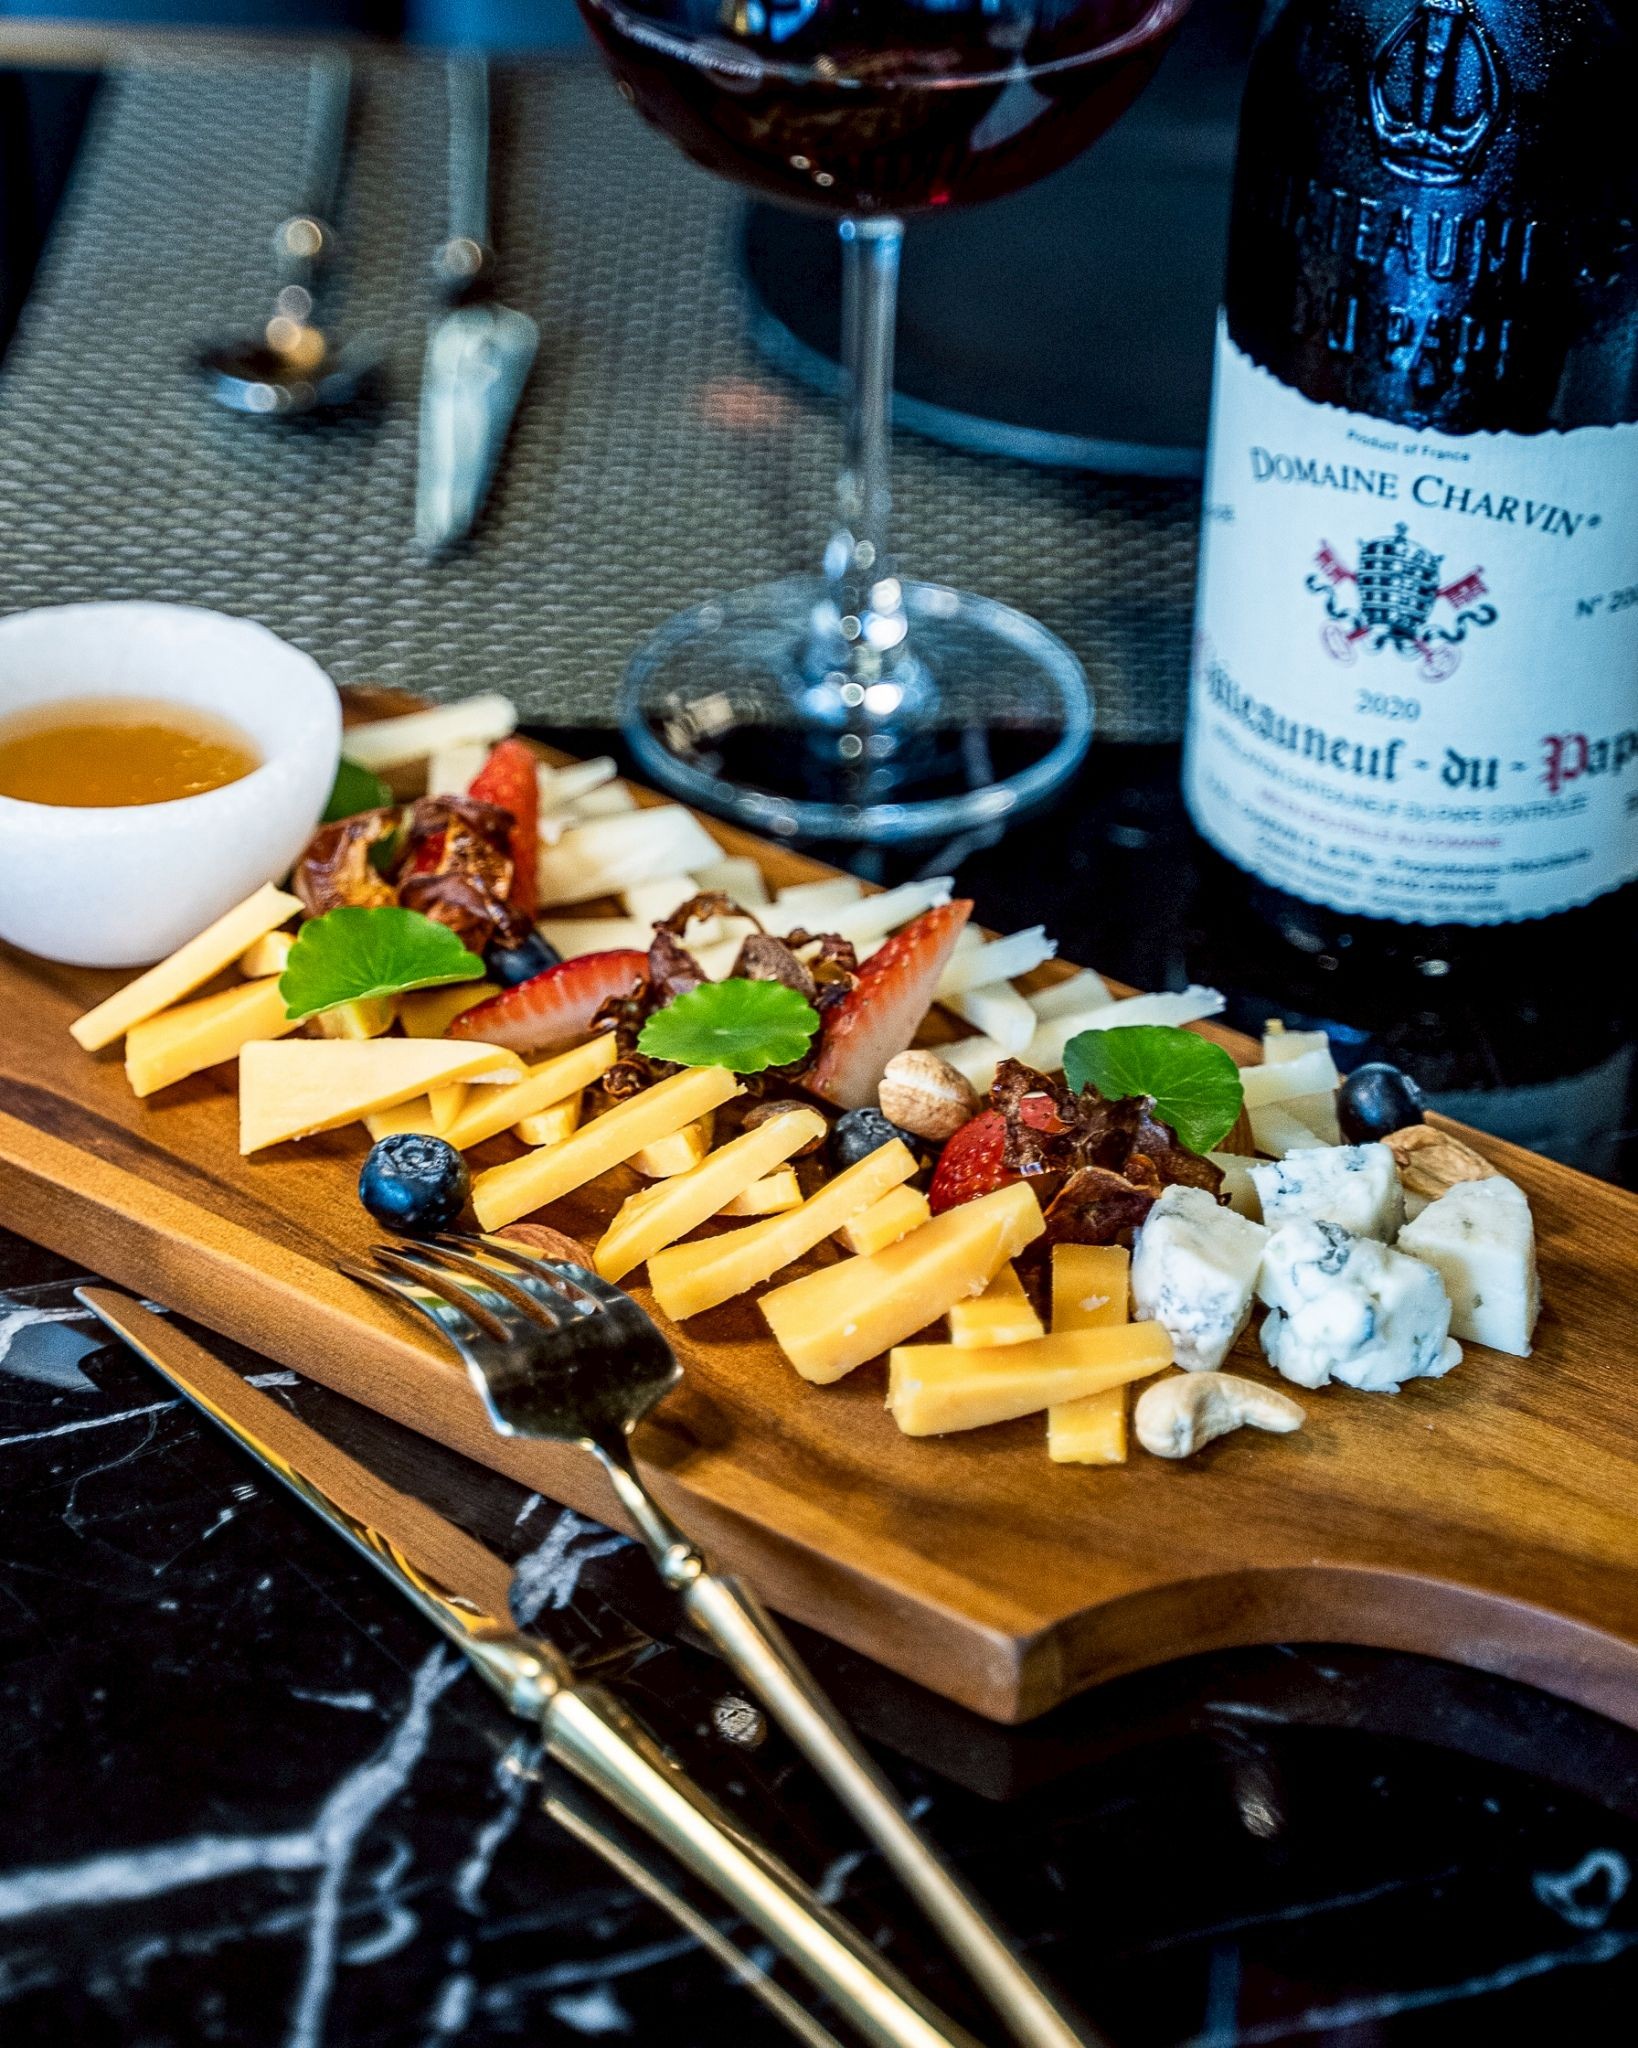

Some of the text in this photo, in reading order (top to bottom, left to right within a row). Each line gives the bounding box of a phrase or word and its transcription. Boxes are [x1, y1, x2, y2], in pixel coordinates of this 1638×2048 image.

[1347, 429, 1471, 462] Product of France
[1249, 445, 1400, 500] DOMAINE
[1356, 688, 1422, 724] 2020
[1441, 744, 1499, 791] du
